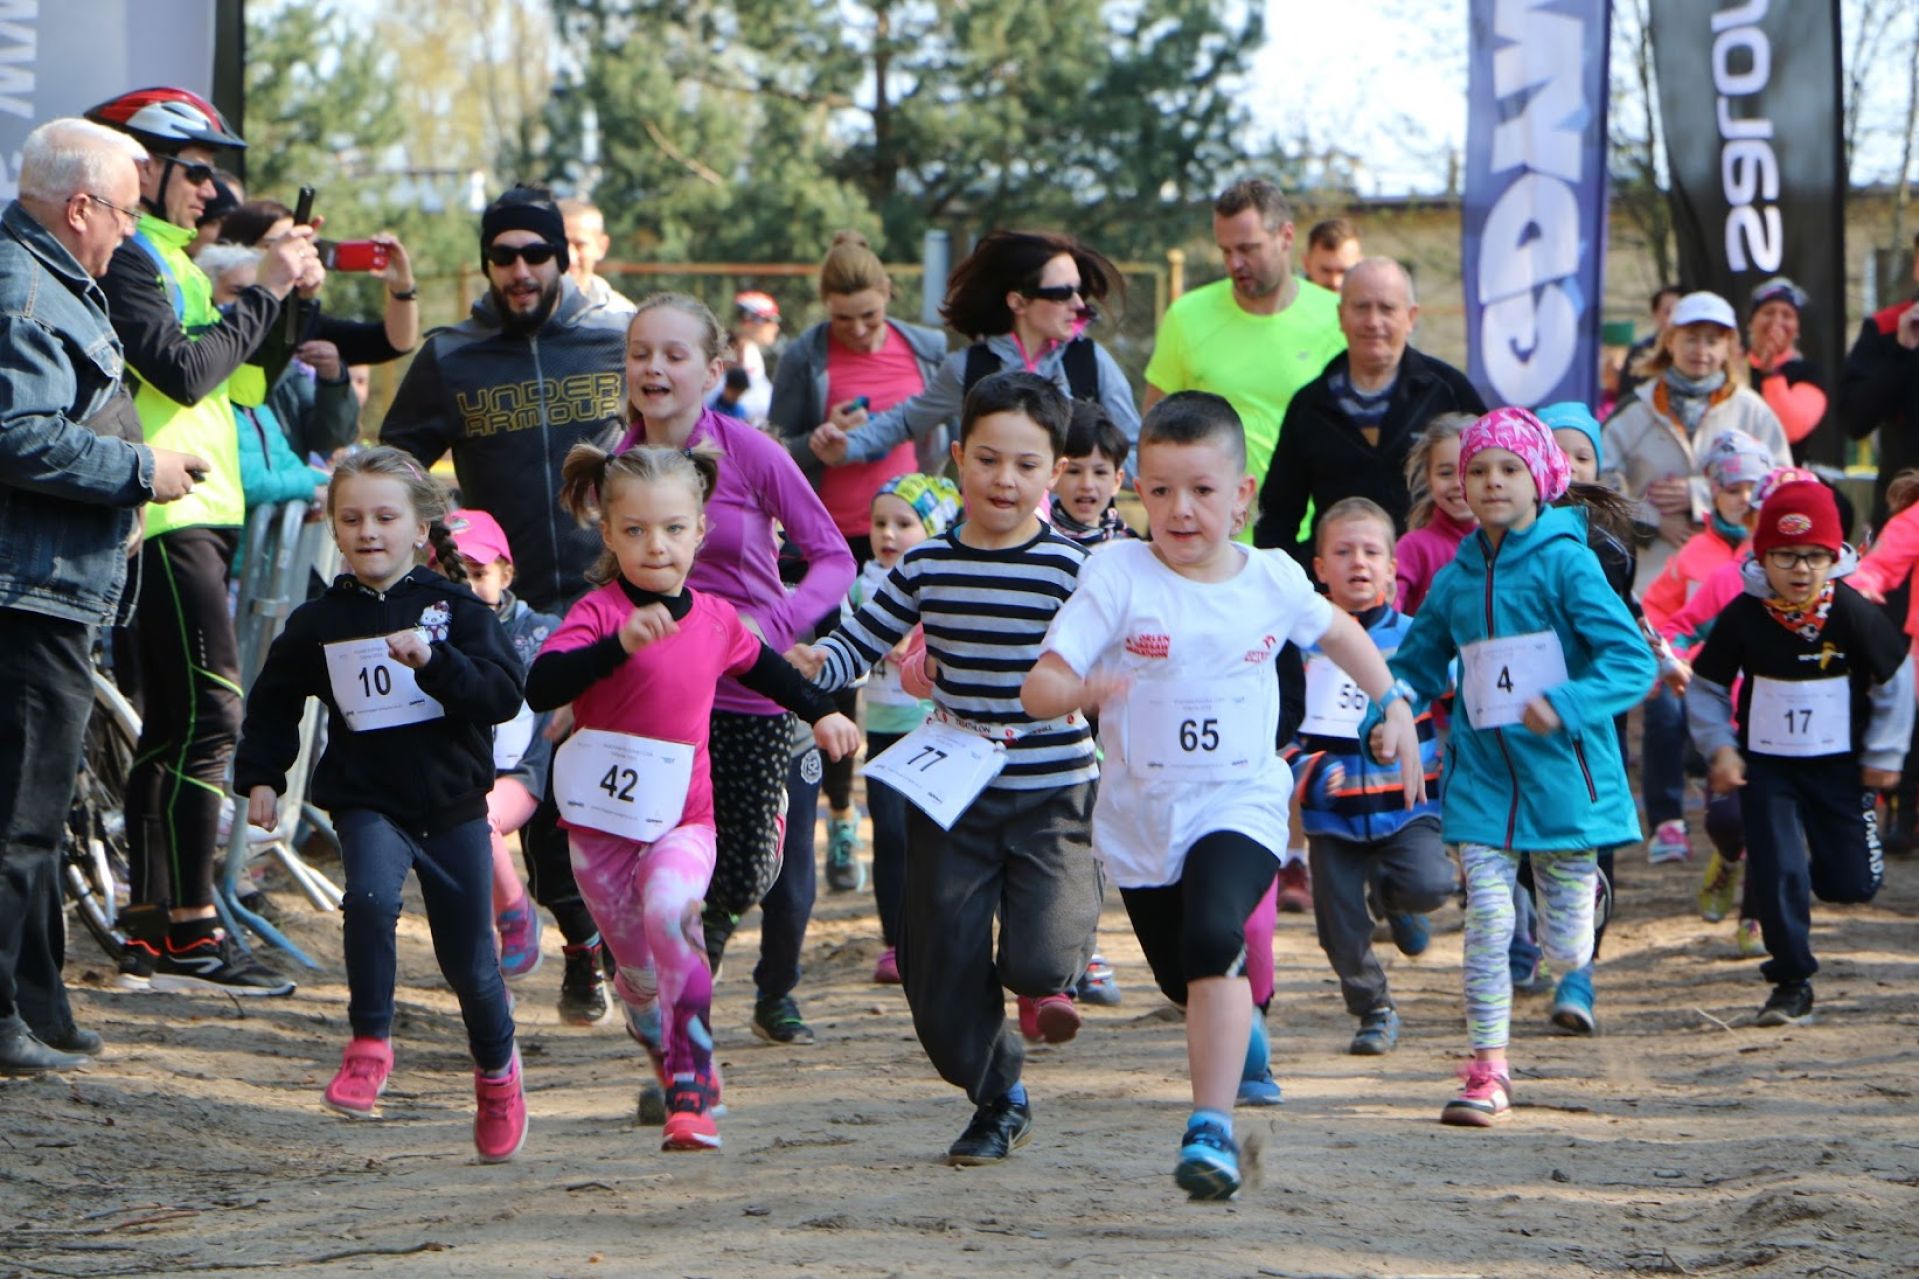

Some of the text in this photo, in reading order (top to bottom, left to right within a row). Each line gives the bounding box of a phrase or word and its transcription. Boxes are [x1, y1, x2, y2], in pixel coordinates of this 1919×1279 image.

[457, 372, 621, 415] UNDER
[466, 398, 621, 436] ARMOUR
[359, 665, 391, 697] 10
[1497, 665, 1514, 693] 4
[1180, 718, 1220, 752] 65
[1784, 708, 1813, 735] 17
[907, 745, 948, 772] 77
[600, 764, 638, 803] 42
